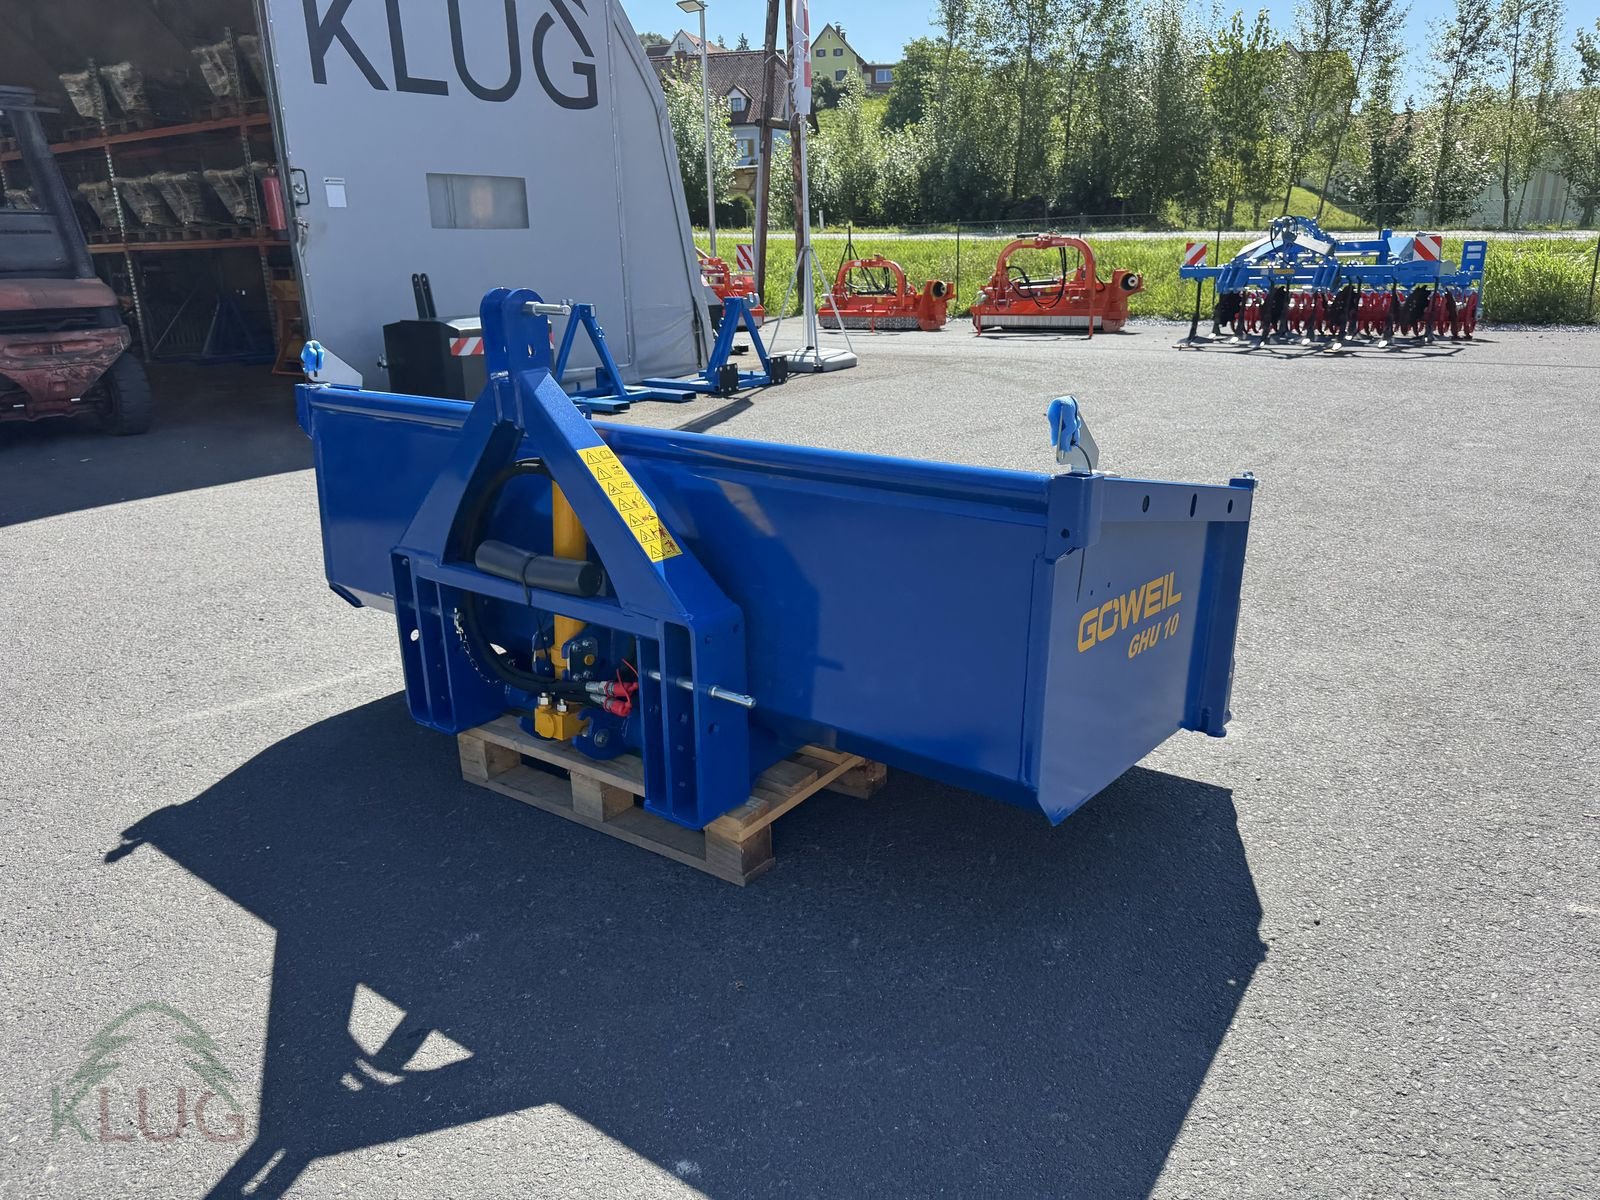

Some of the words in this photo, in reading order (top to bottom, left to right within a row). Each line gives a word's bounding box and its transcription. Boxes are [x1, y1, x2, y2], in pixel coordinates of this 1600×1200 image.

[302, 0, 599, 110] KLUG
[1128, 622, 1161, 659] GHU
[1164, 612, 1180, 640] 10
